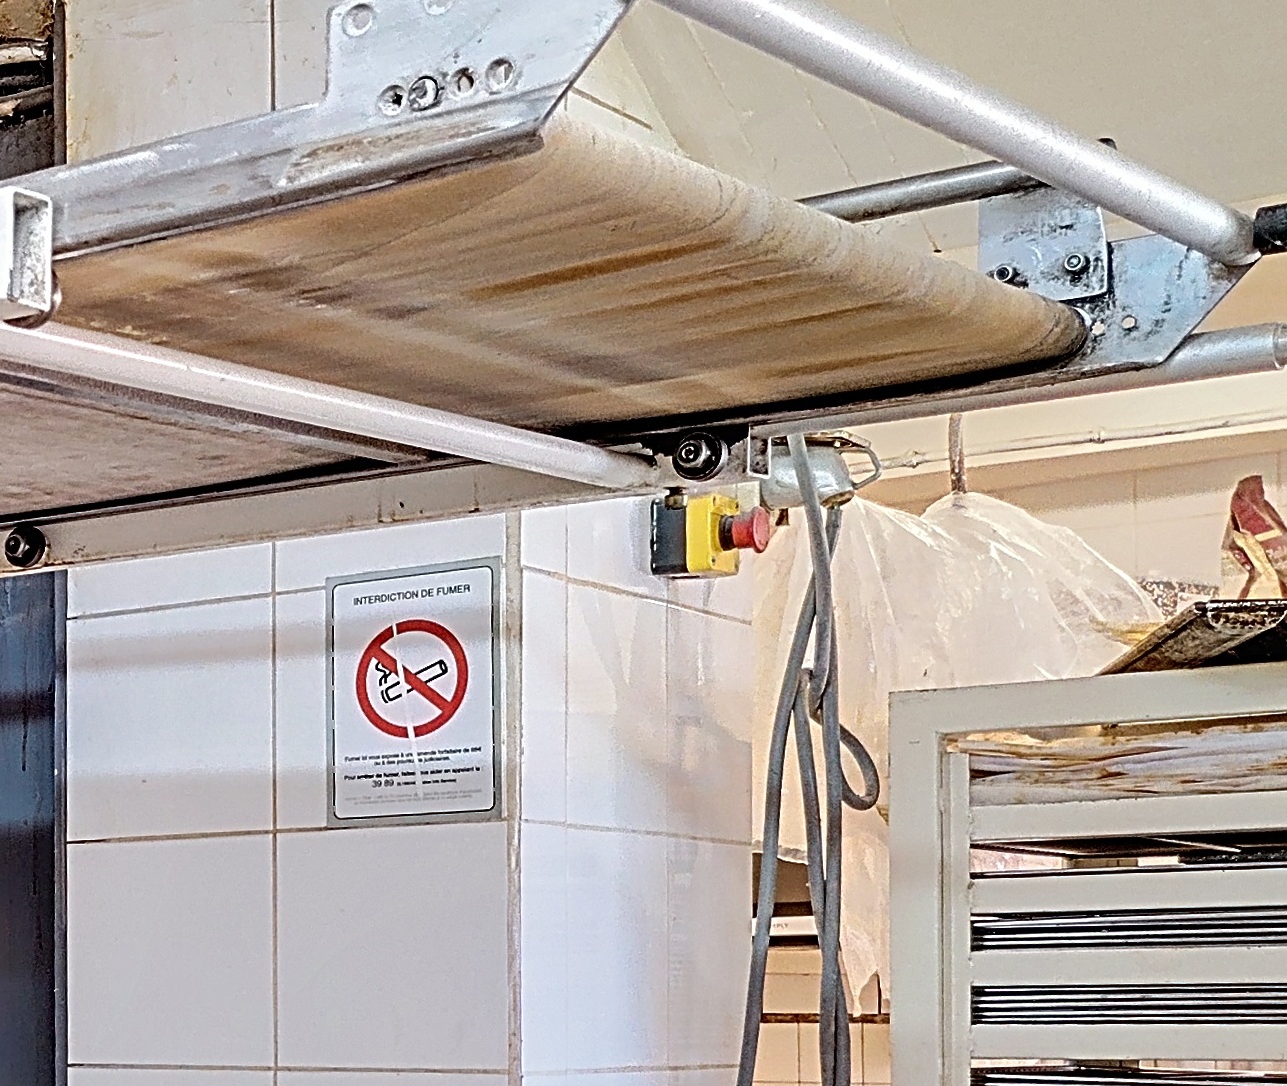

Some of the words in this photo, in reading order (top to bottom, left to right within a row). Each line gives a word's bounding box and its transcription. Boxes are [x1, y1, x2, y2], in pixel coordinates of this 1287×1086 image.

[353, 590, 418, 606] INTERDICTION
[420, 588, 434, 598] DE
[436, 584, 471, 596] FUMER
